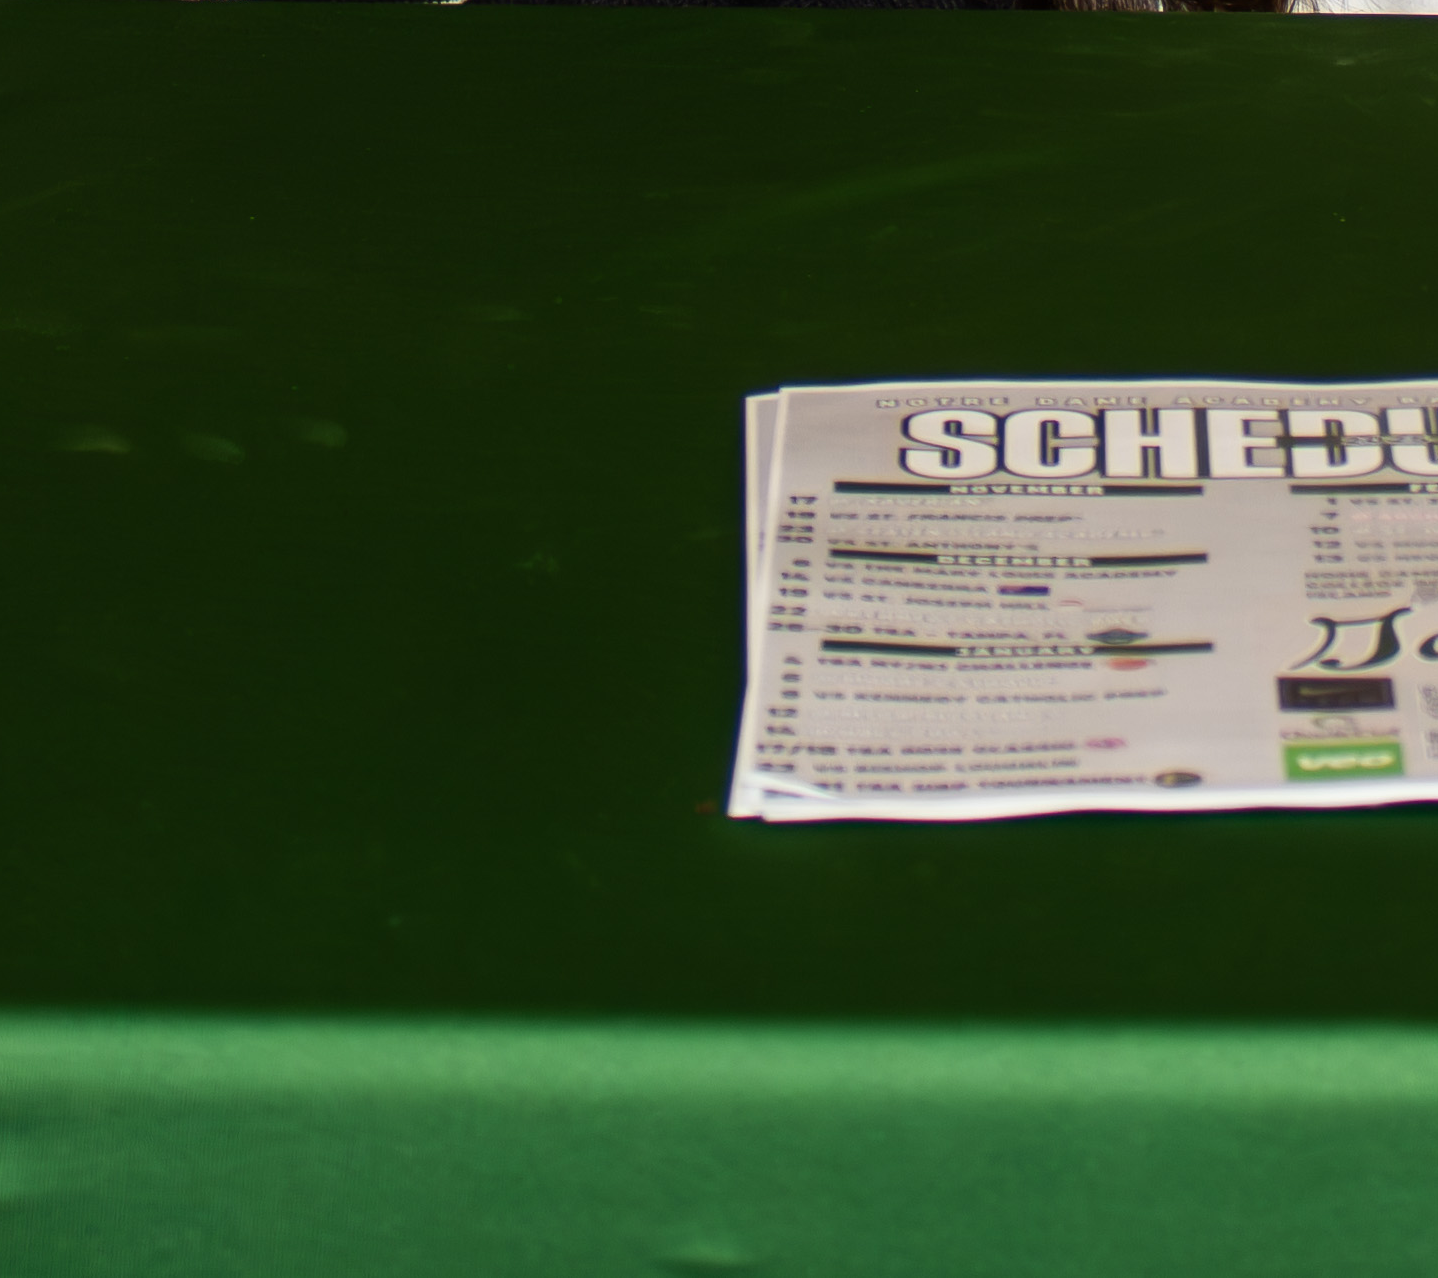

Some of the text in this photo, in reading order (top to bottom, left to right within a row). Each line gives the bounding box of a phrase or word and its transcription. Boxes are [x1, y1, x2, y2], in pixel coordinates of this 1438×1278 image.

[875, 395, 1009, 409] NOTRE
[1035, 395, 1146, 407] DAME
[1174, 395, 1372, 407] ACADEMY
[949, 484, 1105, 497] NOVEMBER
[936, 554, 1093, 568] DECEMBER
[955, 645, 1096, 658] JANUARY
